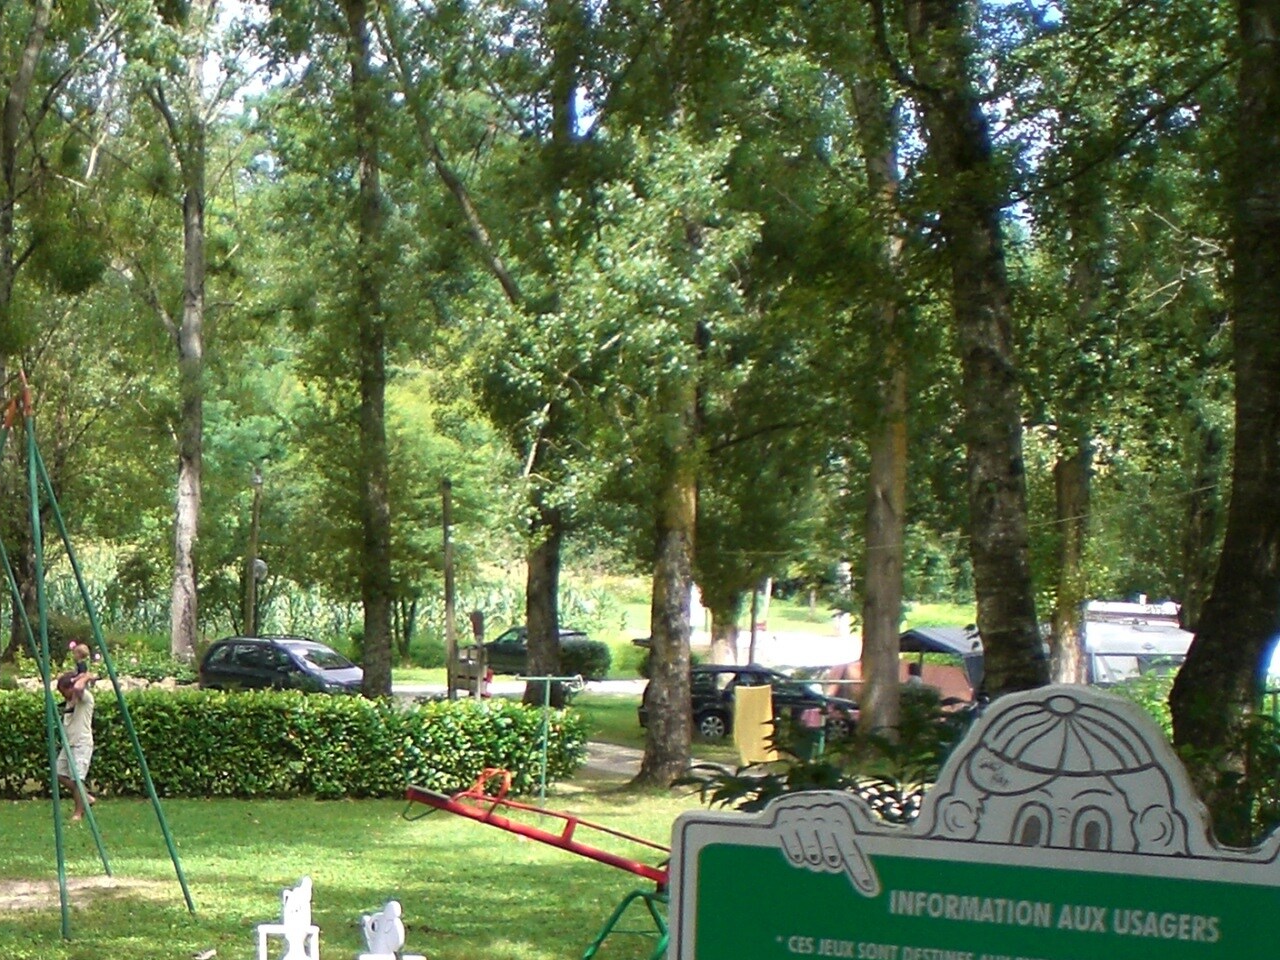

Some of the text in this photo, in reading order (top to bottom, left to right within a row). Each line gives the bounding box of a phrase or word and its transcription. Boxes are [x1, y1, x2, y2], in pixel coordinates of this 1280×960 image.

[889, 889, 1221, 943] INFORMATION AUX USAGERS
[788, 936, 814, 954] CES
[817, 938, 854, 958] JEUX
